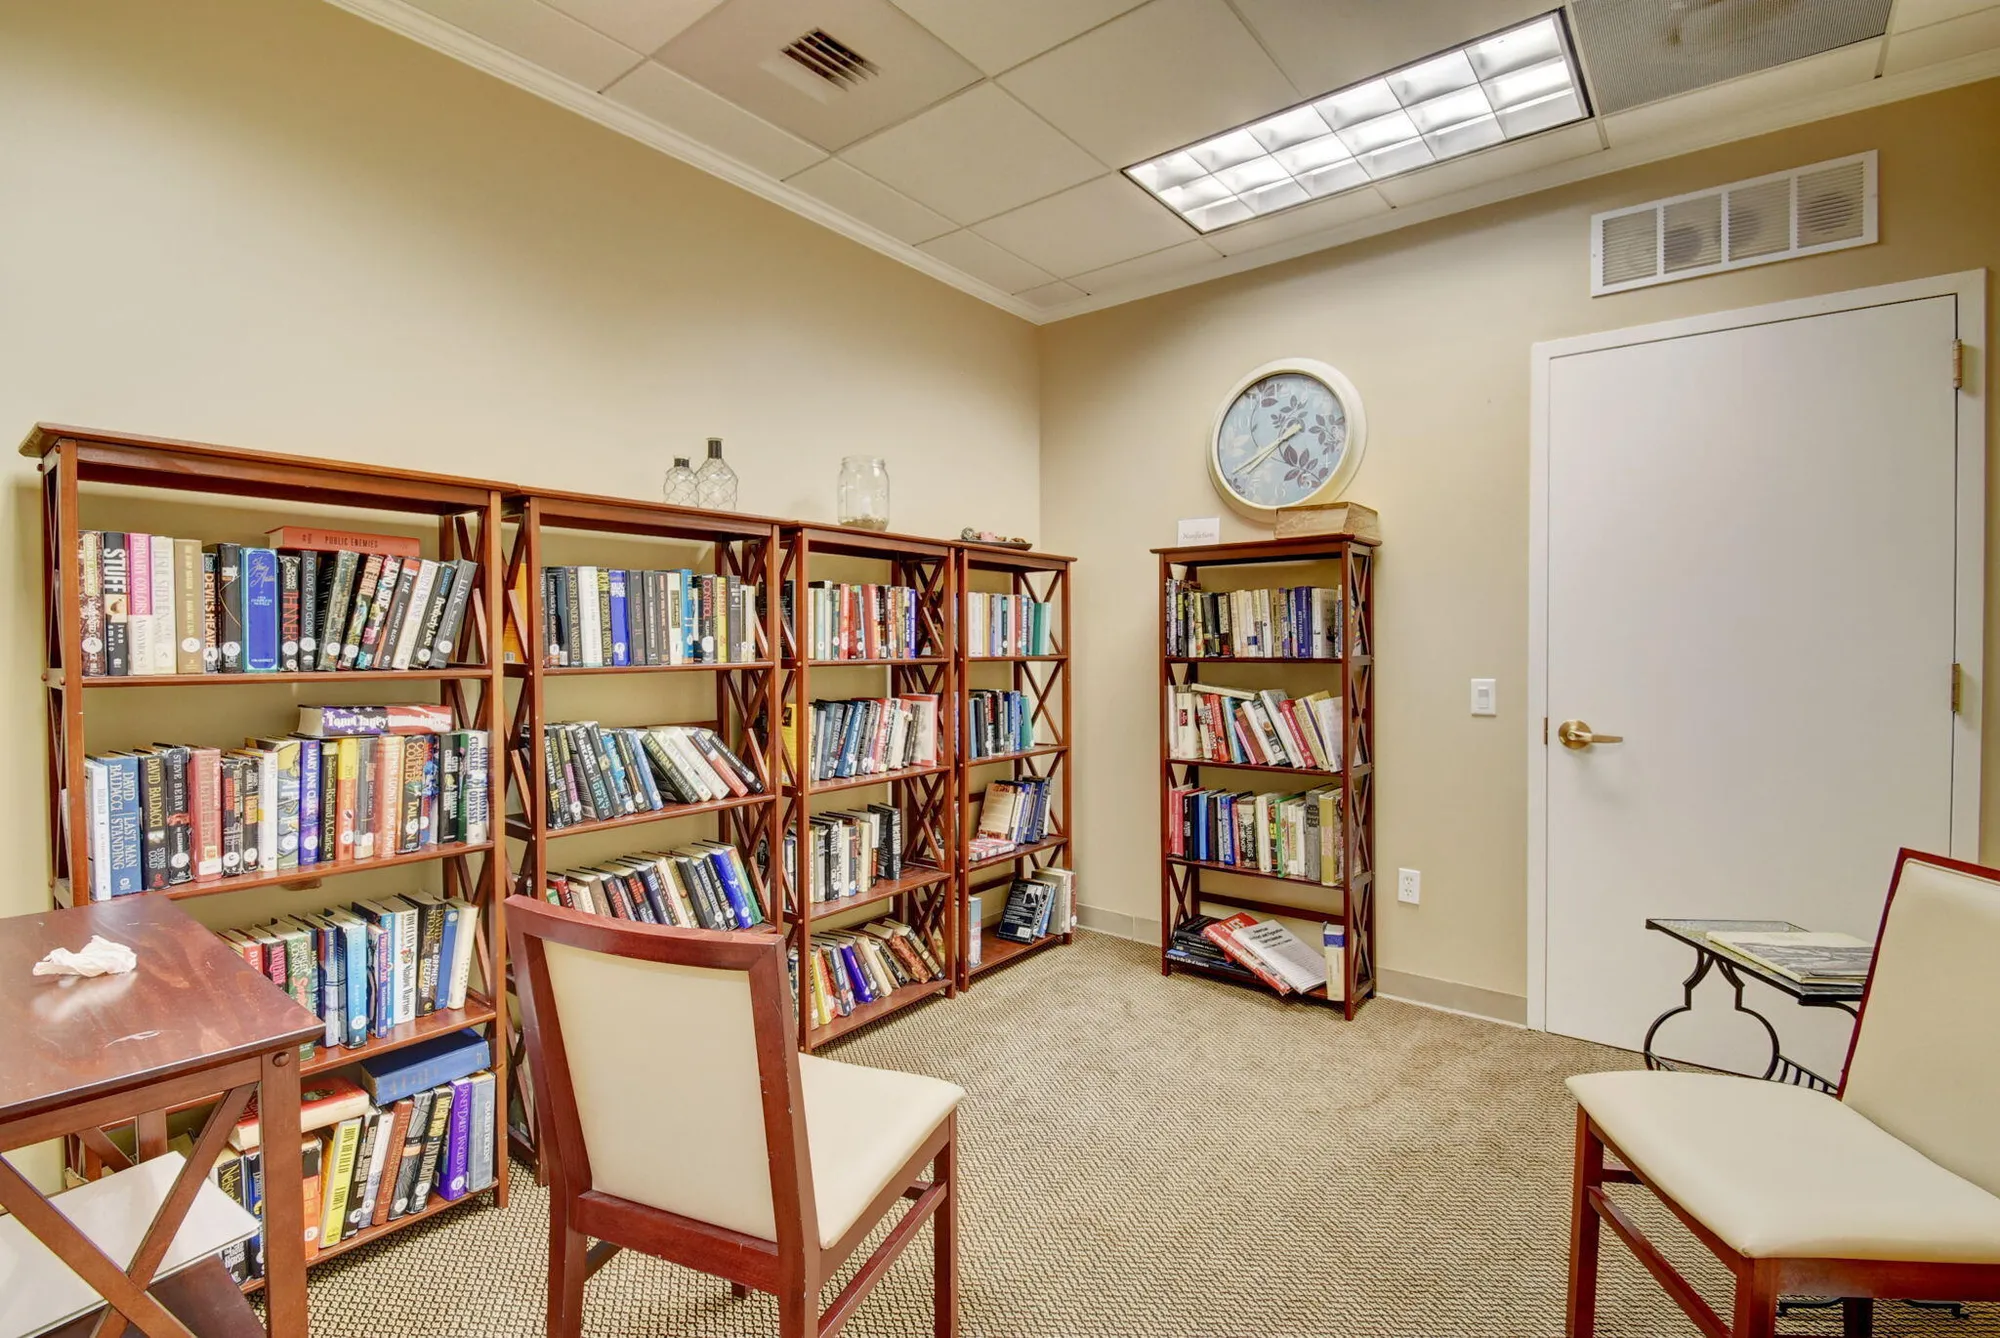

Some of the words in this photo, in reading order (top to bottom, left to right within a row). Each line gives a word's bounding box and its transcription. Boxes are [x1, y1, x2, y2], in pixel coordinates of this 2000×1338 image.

[133, 536, 146, 575] PRIMARY
[325, 535, 348, 546] PUBLIC
[351, 538, 378, 549] ENEMIES
[104, 548, 126, 595] STUFF
[306, 557, 315, 571] FOR
[134, 578, 147, 614] COLORS
[204, 573, 215, 611] DEVIL'S
[306, 573, 315, 592] LOVE
[453, 579, 469, 606] LINK
[569, 573, 577, 598] JOSEPH
[306, 594, 315, 610] AND
[427, 596, 446, 628] Brotherly
[570, 599, 578, 624] FINDER
[702, 579, 711, 619] CONTROL
[283, 591, 300, 641] THINNER
[305, 612, 315, 636] GLORY
[393, 602, 404, 627] LAWRENCE
[205, 614, 215, 649] HEAVE
[388, 629, 397, 645] BLOCK
[423, 630, 436, 647] Love
[571, 626, 579, 660] VANISHED
[173, 754, 182, 780] STEVE
[307, 748, 317, 769] MARY
[405, 742, 416, 783] COULTER
[469, 736, 478, 771] CUSSLER
[479, 747, 487, 770] CLIVE
[578, 739, 594, 774] GREANEY
[585, 743, 596, 765] MARK
[148, 759, 160, 784] DAVID
[306, 772, 316, 788] JANE
[110, 764, 123, 810] BALDACCI
[124, 772, 135, 801] DAVID
[173, 783, 183, 812] BERRY
[591, 782, 606, 809] GRAY
[149, 787, 162, 828] BALDACCI
[306, 790, 316, 816] CLARK
[325, 788, 335, 817] Richard
[469, 790, 478, 825] ODYSSEY
[478, 790, 487, 821] TROJAN
[124, 816, 136, 841] LAST
[406, 799, 418, 840] TAILSN
[112, 818, 124, 870] STANDING
[325, 826, 334, 852] Clarke
[125, 844, 137, 868] MAN
[149, 850, 158, 869] COLD
[157, 847, 165, 869] STONE
[421, 958, 431, 998] DECEPTION
[430, 954, 439, 986] ORPHEUS
